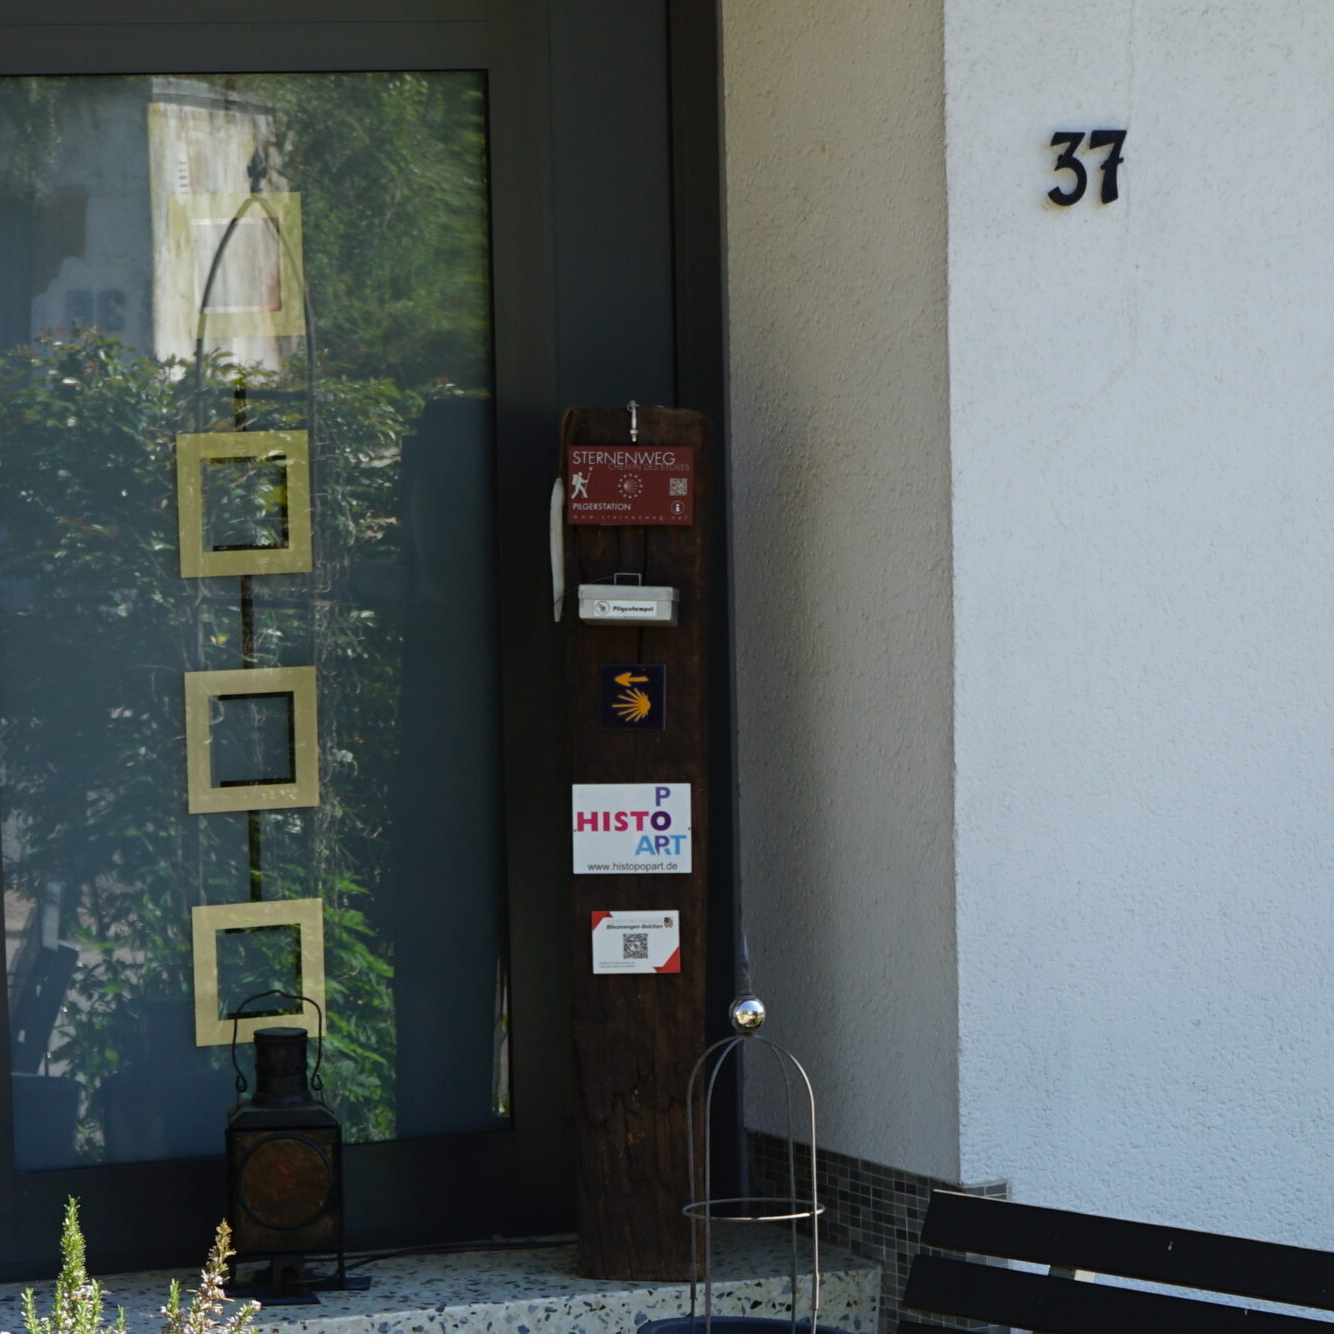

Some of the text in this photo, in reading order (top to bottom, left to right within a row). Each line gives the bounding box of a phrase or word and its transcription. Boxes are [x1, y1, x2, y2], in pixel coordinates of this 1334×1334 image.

[1048, 130, 1127, 206] 37
[572, 451, 676, 465] STERNENWEG
[572, 503, 631, 511] PILGERSTATION
[587, 862, 678, 872] www.histopopart.de
